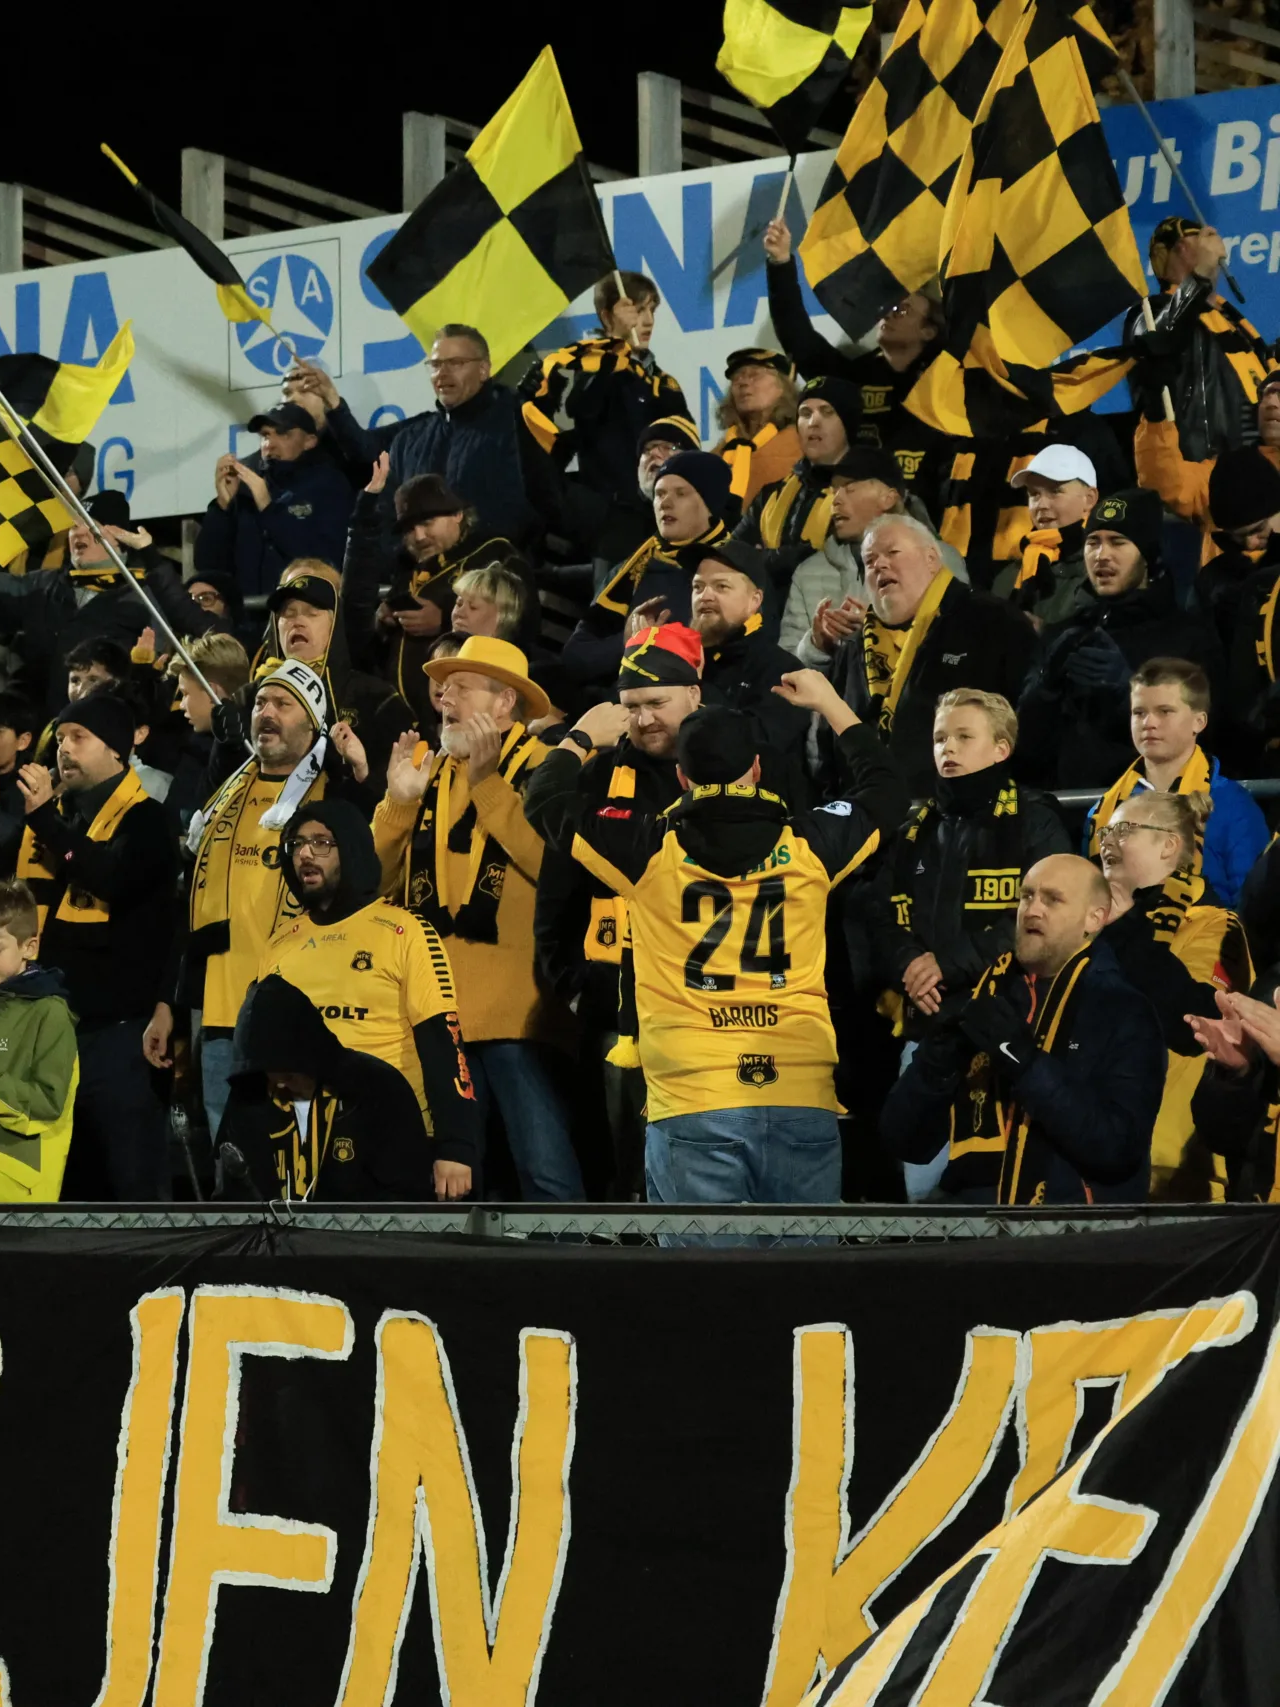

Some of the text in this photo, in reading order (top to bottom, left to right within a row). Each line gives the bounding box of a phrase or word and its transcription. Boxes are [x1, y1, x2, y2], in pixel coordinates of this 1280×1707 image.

[973, 876, 1021, 902] 190
[680, 877, 791, 992] 24
[708, 1004, 779, 1028] BARROS
[742, 1055, 771, 1067] MFK
